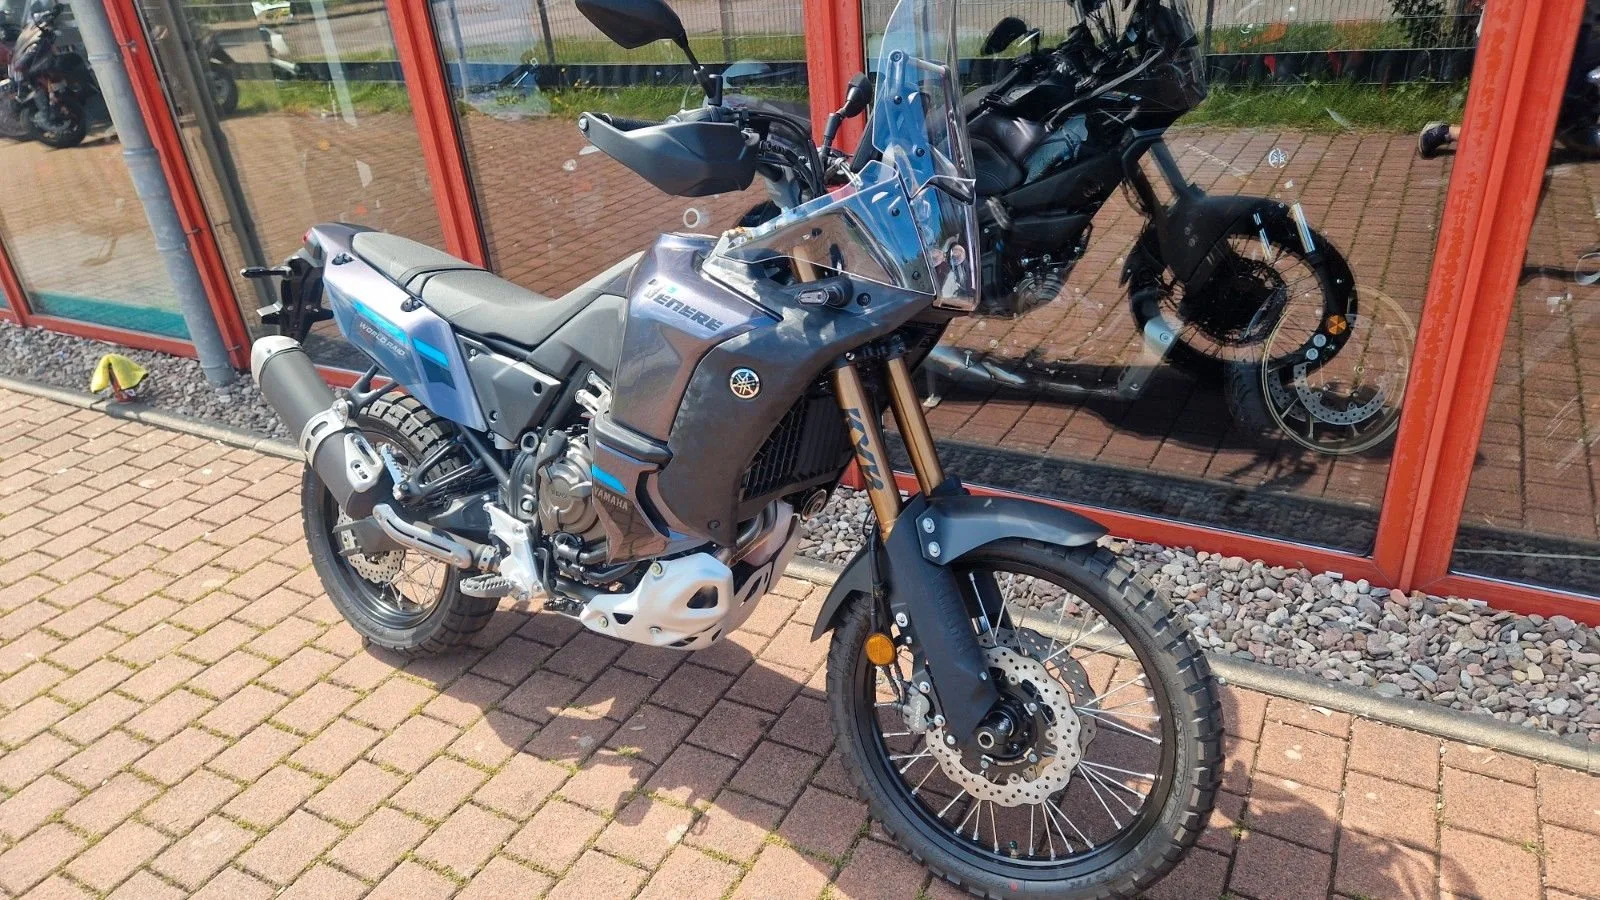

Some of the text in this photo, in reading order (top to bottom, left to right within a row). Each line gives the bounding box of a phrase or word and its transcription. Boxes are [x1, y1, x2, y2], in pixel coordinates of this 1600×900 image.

[359, 321, 405, 356] WORLD RAID
[840, 407, 884, 490] KYB
[593, 486, 628, 510] YAMAHA
